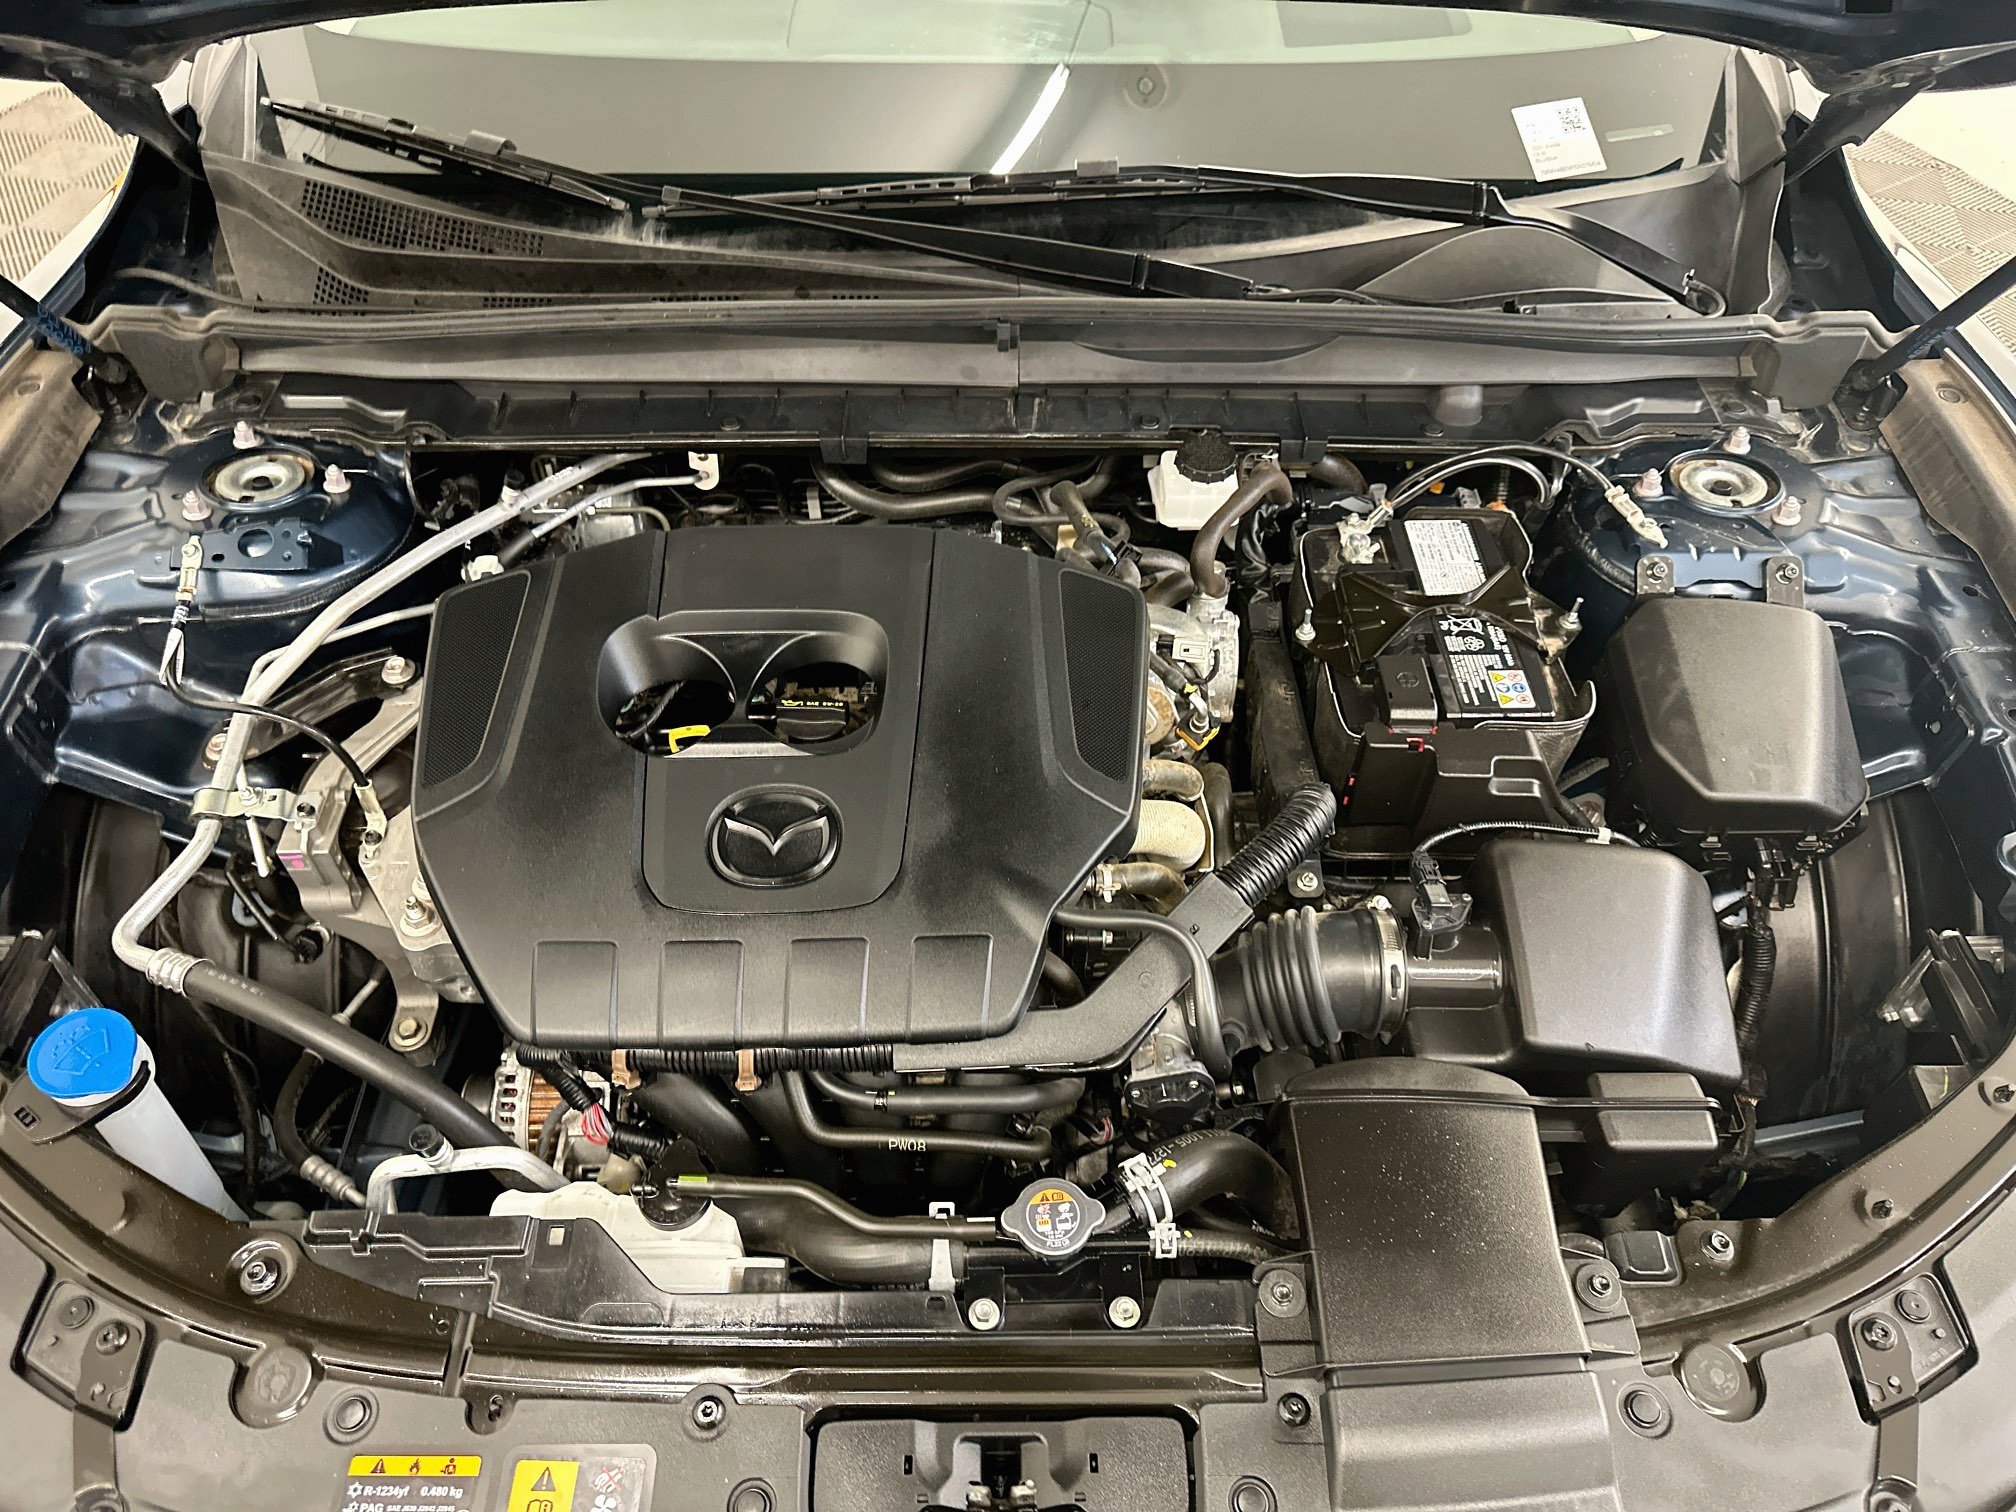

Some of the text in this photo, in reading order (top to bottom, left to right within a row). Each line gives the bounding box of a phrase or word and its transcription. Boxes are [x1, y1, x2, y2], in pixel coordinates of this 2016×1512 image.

[1439, 620, 1450, 630] Pb
[888, 1138, 926, 1152] PW08
[1175, 1132, 1205, 1148] 1005
[363, 1485, 464, 1499] R-1234yf 0.480 kg
[360, 1502, 384, 1512] PAG
